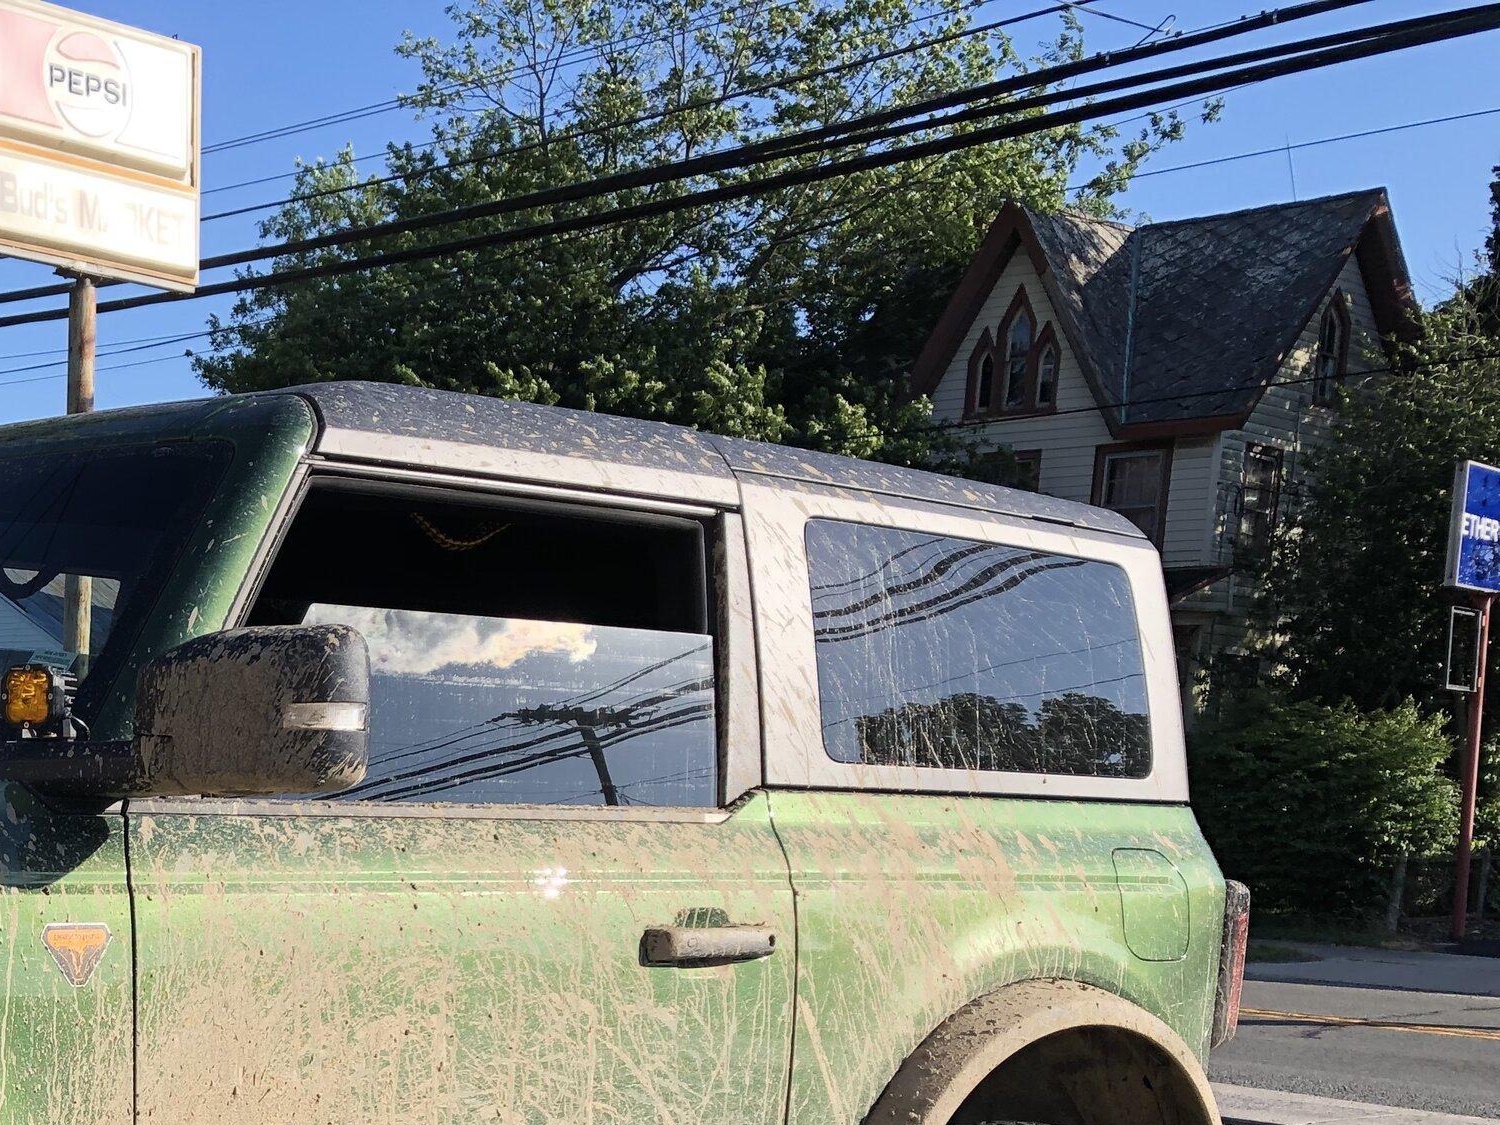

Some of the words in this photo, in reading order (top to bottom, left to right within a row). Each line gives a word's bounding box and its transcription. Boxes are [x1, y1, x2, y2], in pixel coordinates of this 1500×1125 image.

[48, 64, 127, 107] PEPSI
[0, 170, 67, 225] Bud's
[78, 188, 186, 248] MRKET
